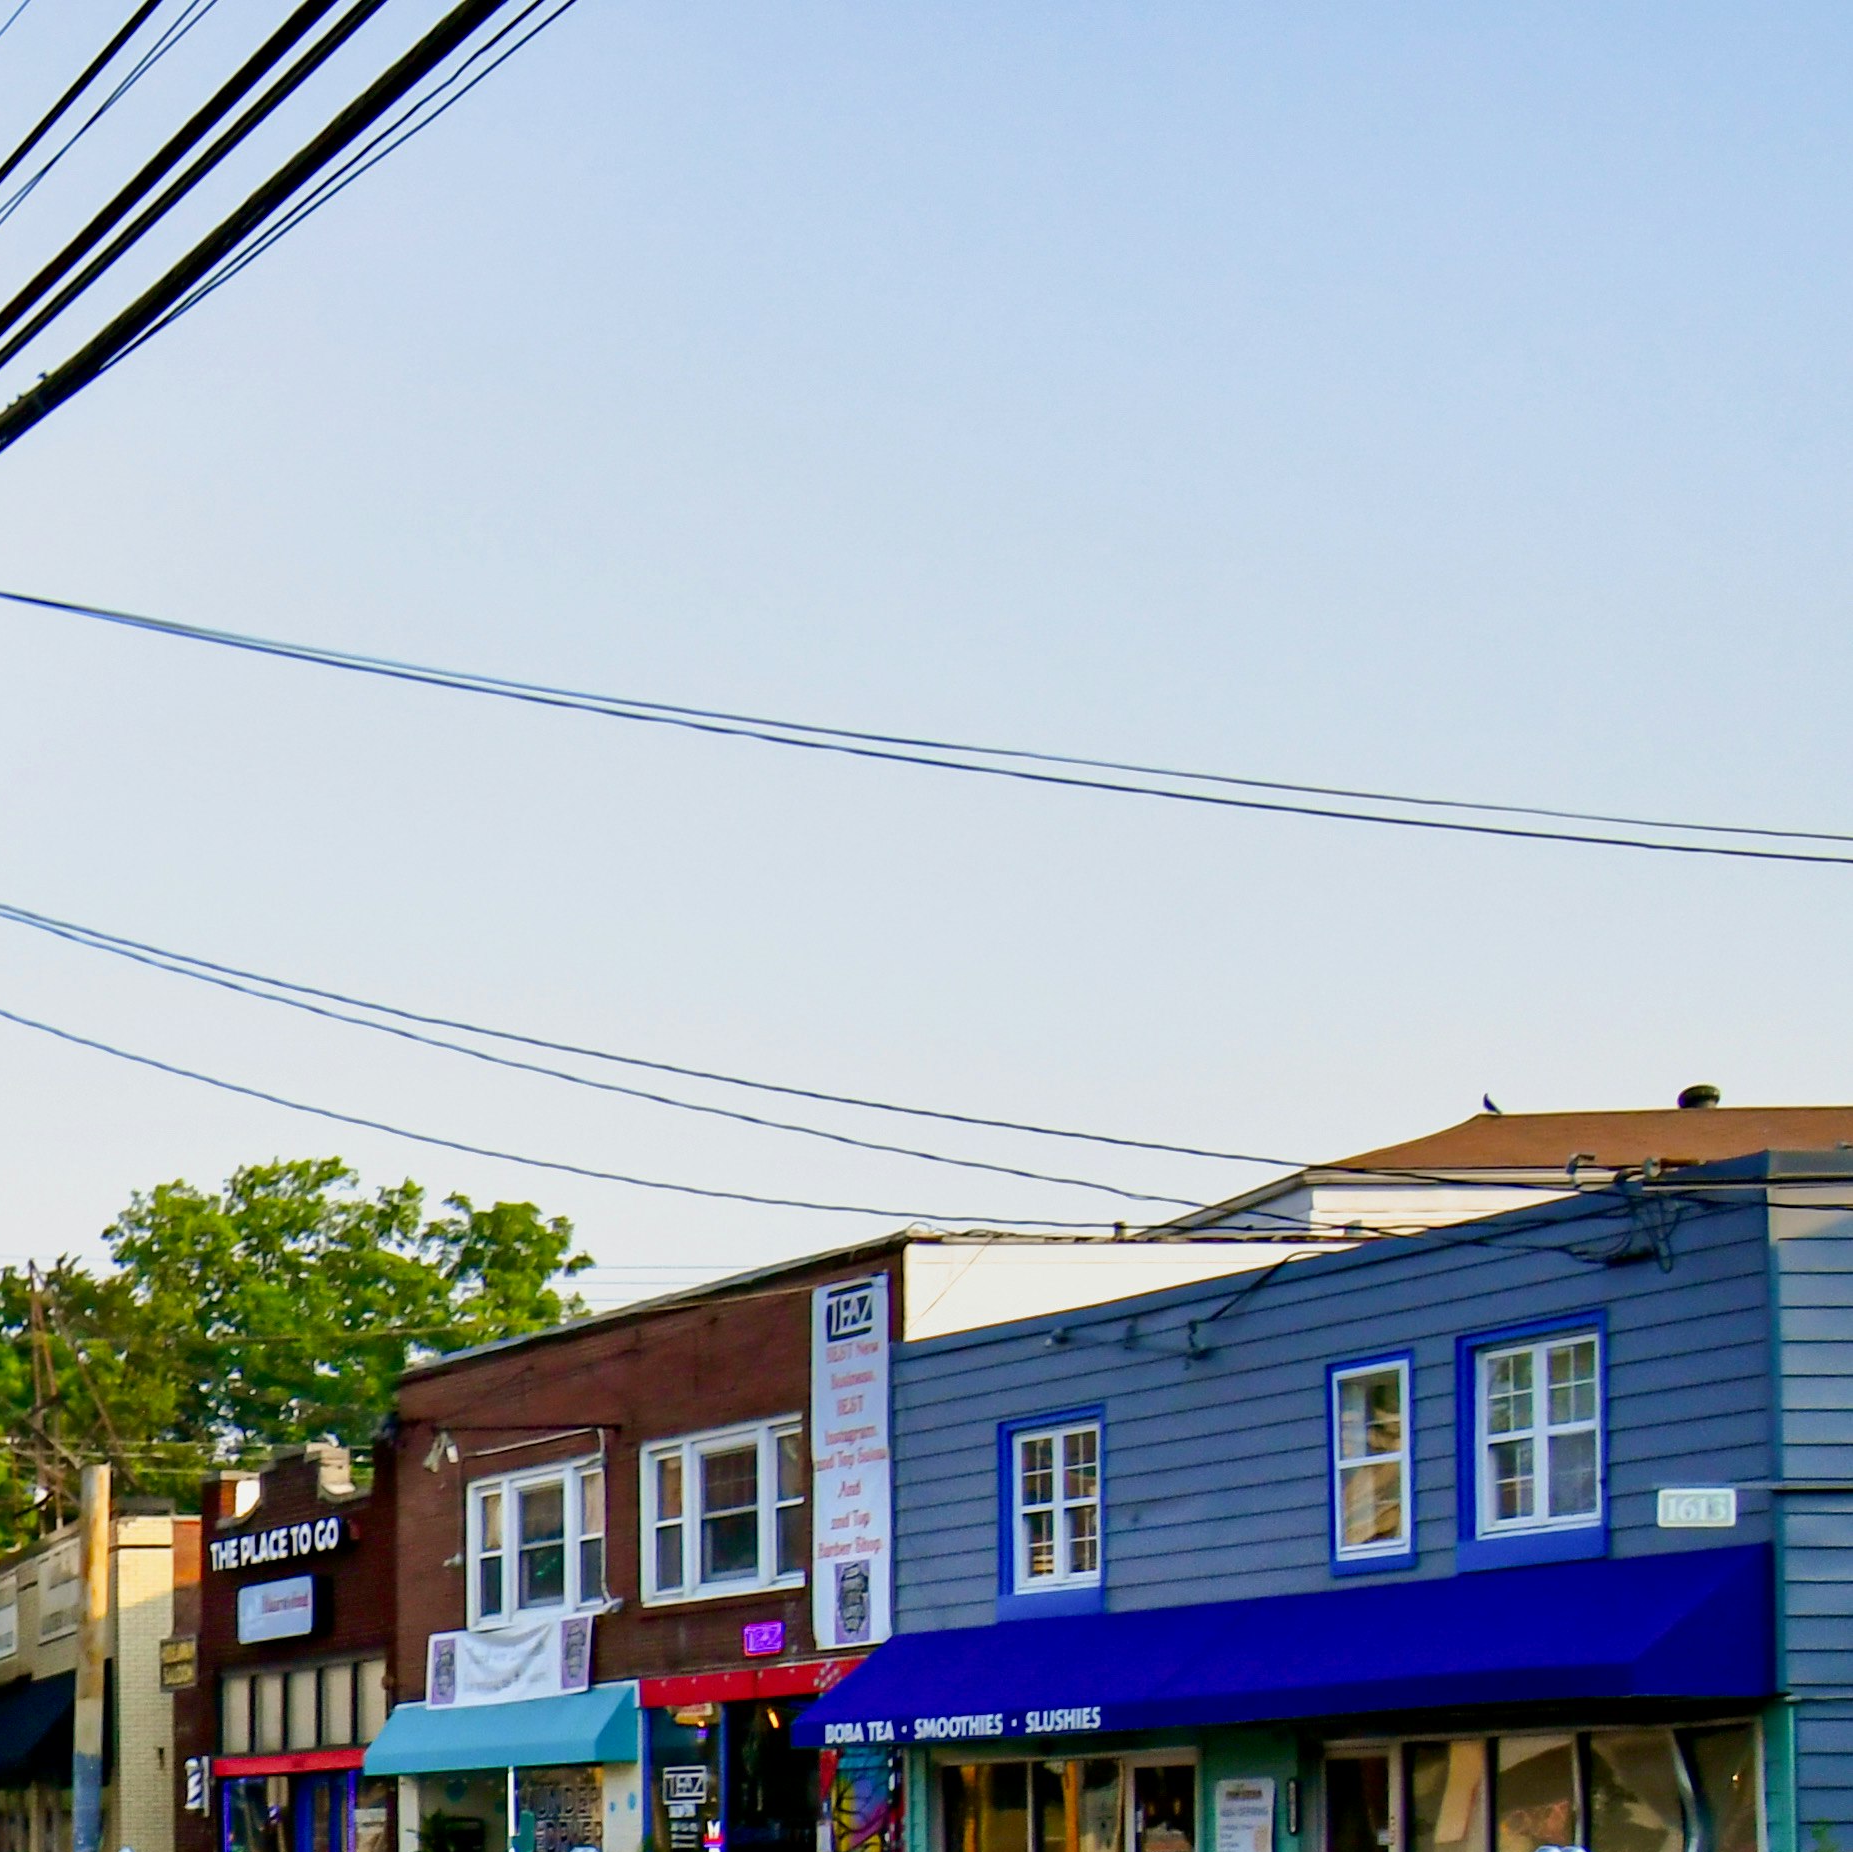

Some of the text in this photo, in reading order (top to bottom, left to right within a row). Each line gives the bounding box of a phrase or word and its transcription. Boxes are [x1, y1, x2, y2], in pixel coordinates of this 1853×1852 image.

[209, 1516, 340, 1572] THE PLACE TO GO
[824, 1705, 1102, 1745] BOBA TEA SMOOTHIES SLUSHIES
